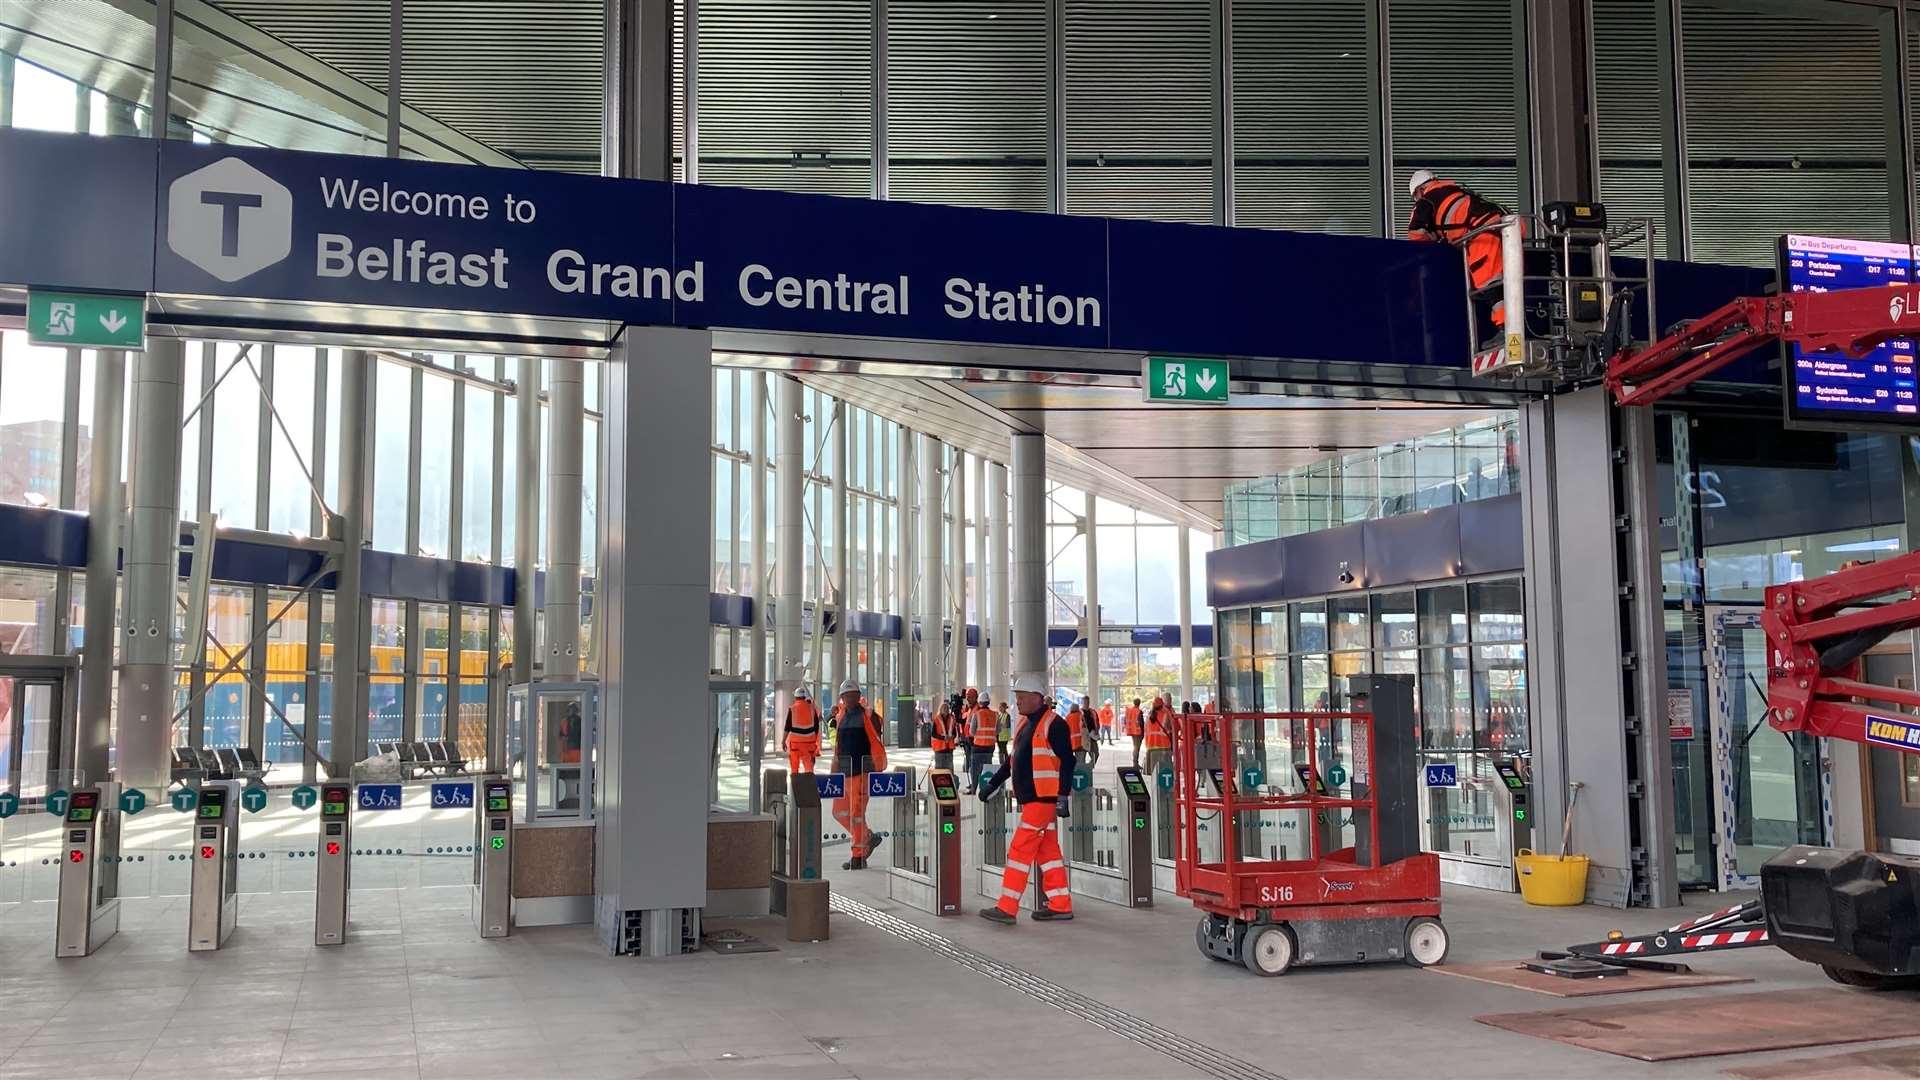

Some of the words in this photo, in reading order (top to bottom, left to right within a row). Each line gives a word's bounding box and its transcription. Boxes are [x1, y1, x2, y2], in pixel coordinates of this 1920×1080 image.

[320, 177, 489, 221] Welcome
[505, 194, 536, 224] to
[201, 191, 262, 257] T
[1821, 241, 1857, 252] Departures
[1808, 261, 1842, 271] Portadown
[1868, 266, 1881, 274] D17
[317, 233, 509, 289] Belfast
[547, 250, 705, 303] Grand
[739, 265, 909, 315] Central
[945, 278, 1101, 327] Station
[1814, 361, 1848, 371] Aldergrove
[1816, 386, 1849, 396] Sydenham
[1870, 721, 1907, 742] KDM
